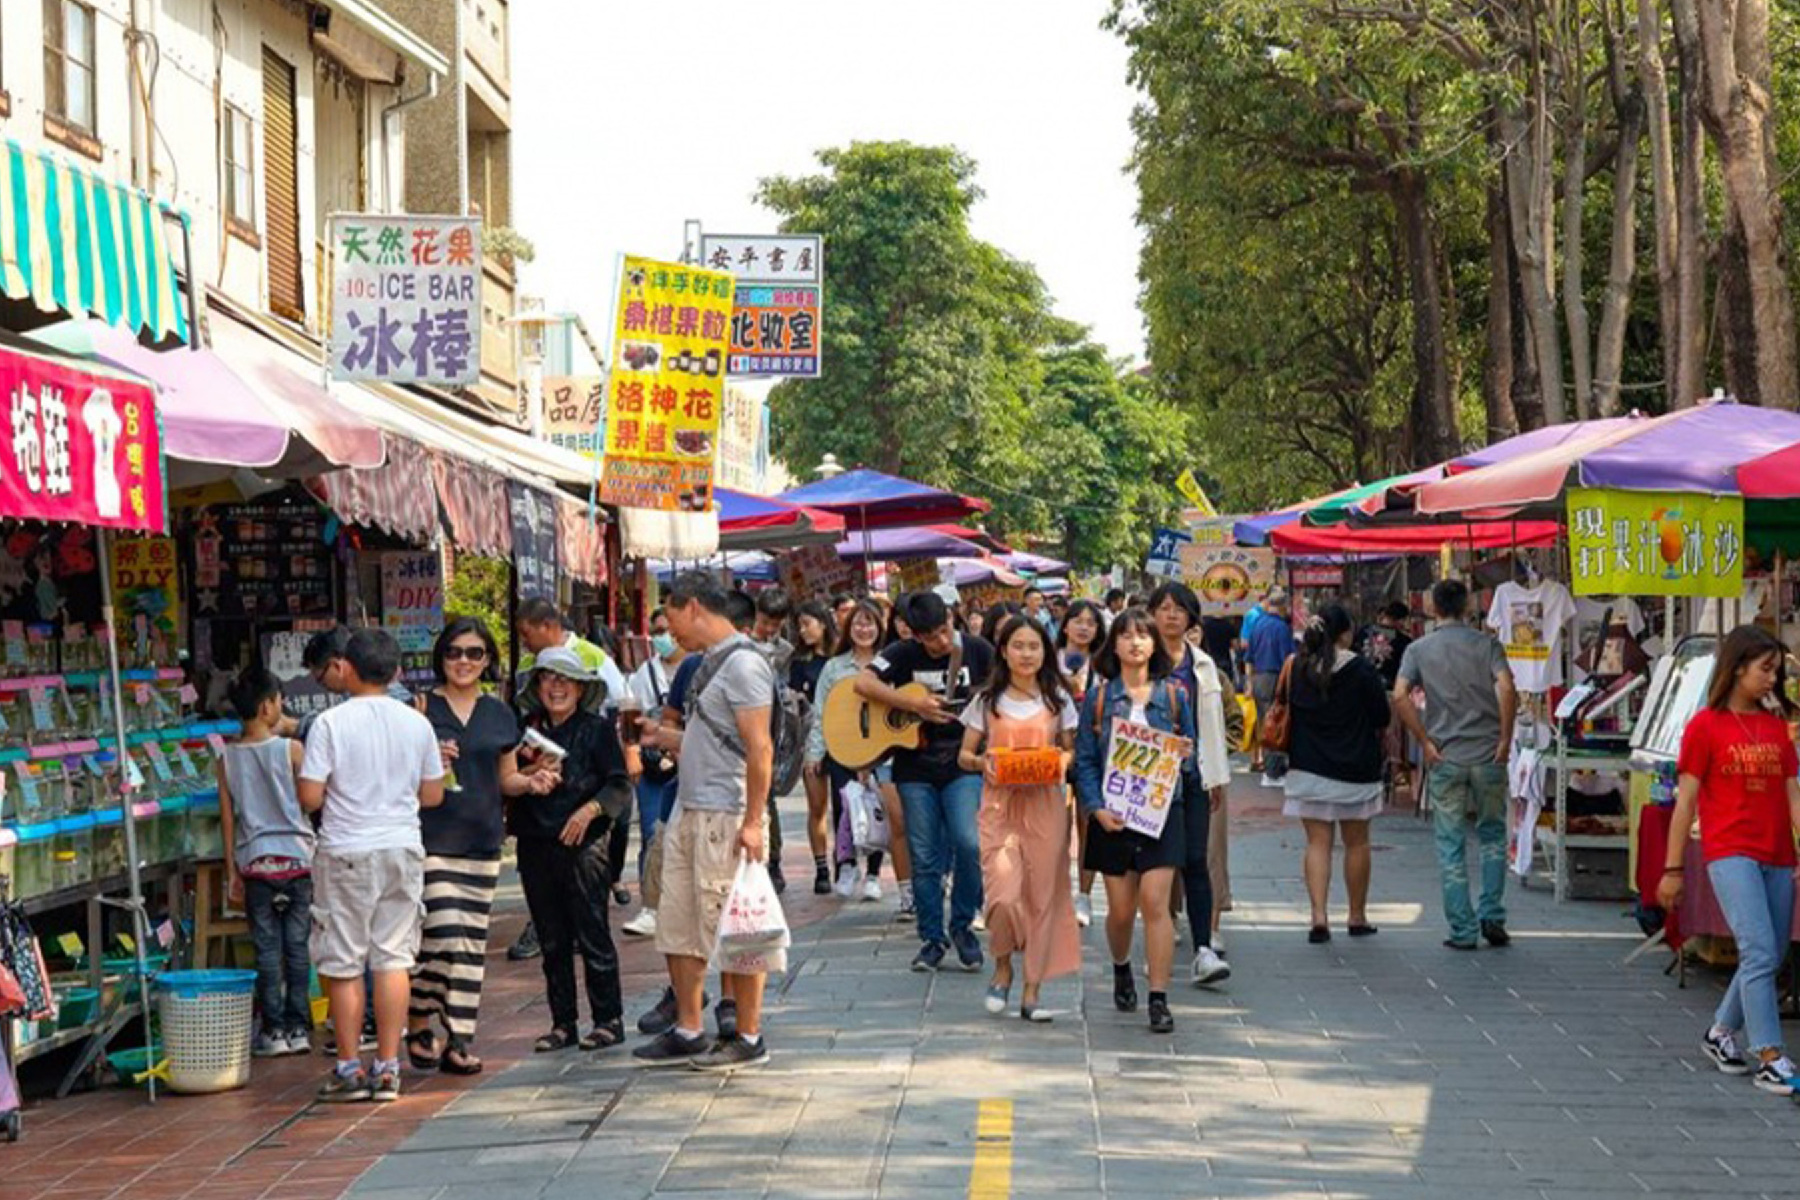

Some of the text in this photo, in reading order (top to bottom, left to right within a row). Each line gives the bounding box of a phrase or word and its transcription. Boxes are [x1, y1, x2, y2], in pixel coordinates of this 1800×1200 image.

[342, 226, 474, 266] 天然花果
[707, 245, 815, 272] 安平書屋
[379, 273, 416, 300] ICE
[428, 274, 474, 301] BAR
[341, 307, 472, 378] 冰棒
[617, 380, 714, 420] 洛神花
[1575, 507, 1607, 578] 現打
[1612, 517, 1739, 577] 果汁 冰沙
[116, 568, 174, 590] DIY
[397, 586, 439, 610] DIY
[1112, 737, 1161, 773] 7/27
[1125, 806, 1160, 833] House
